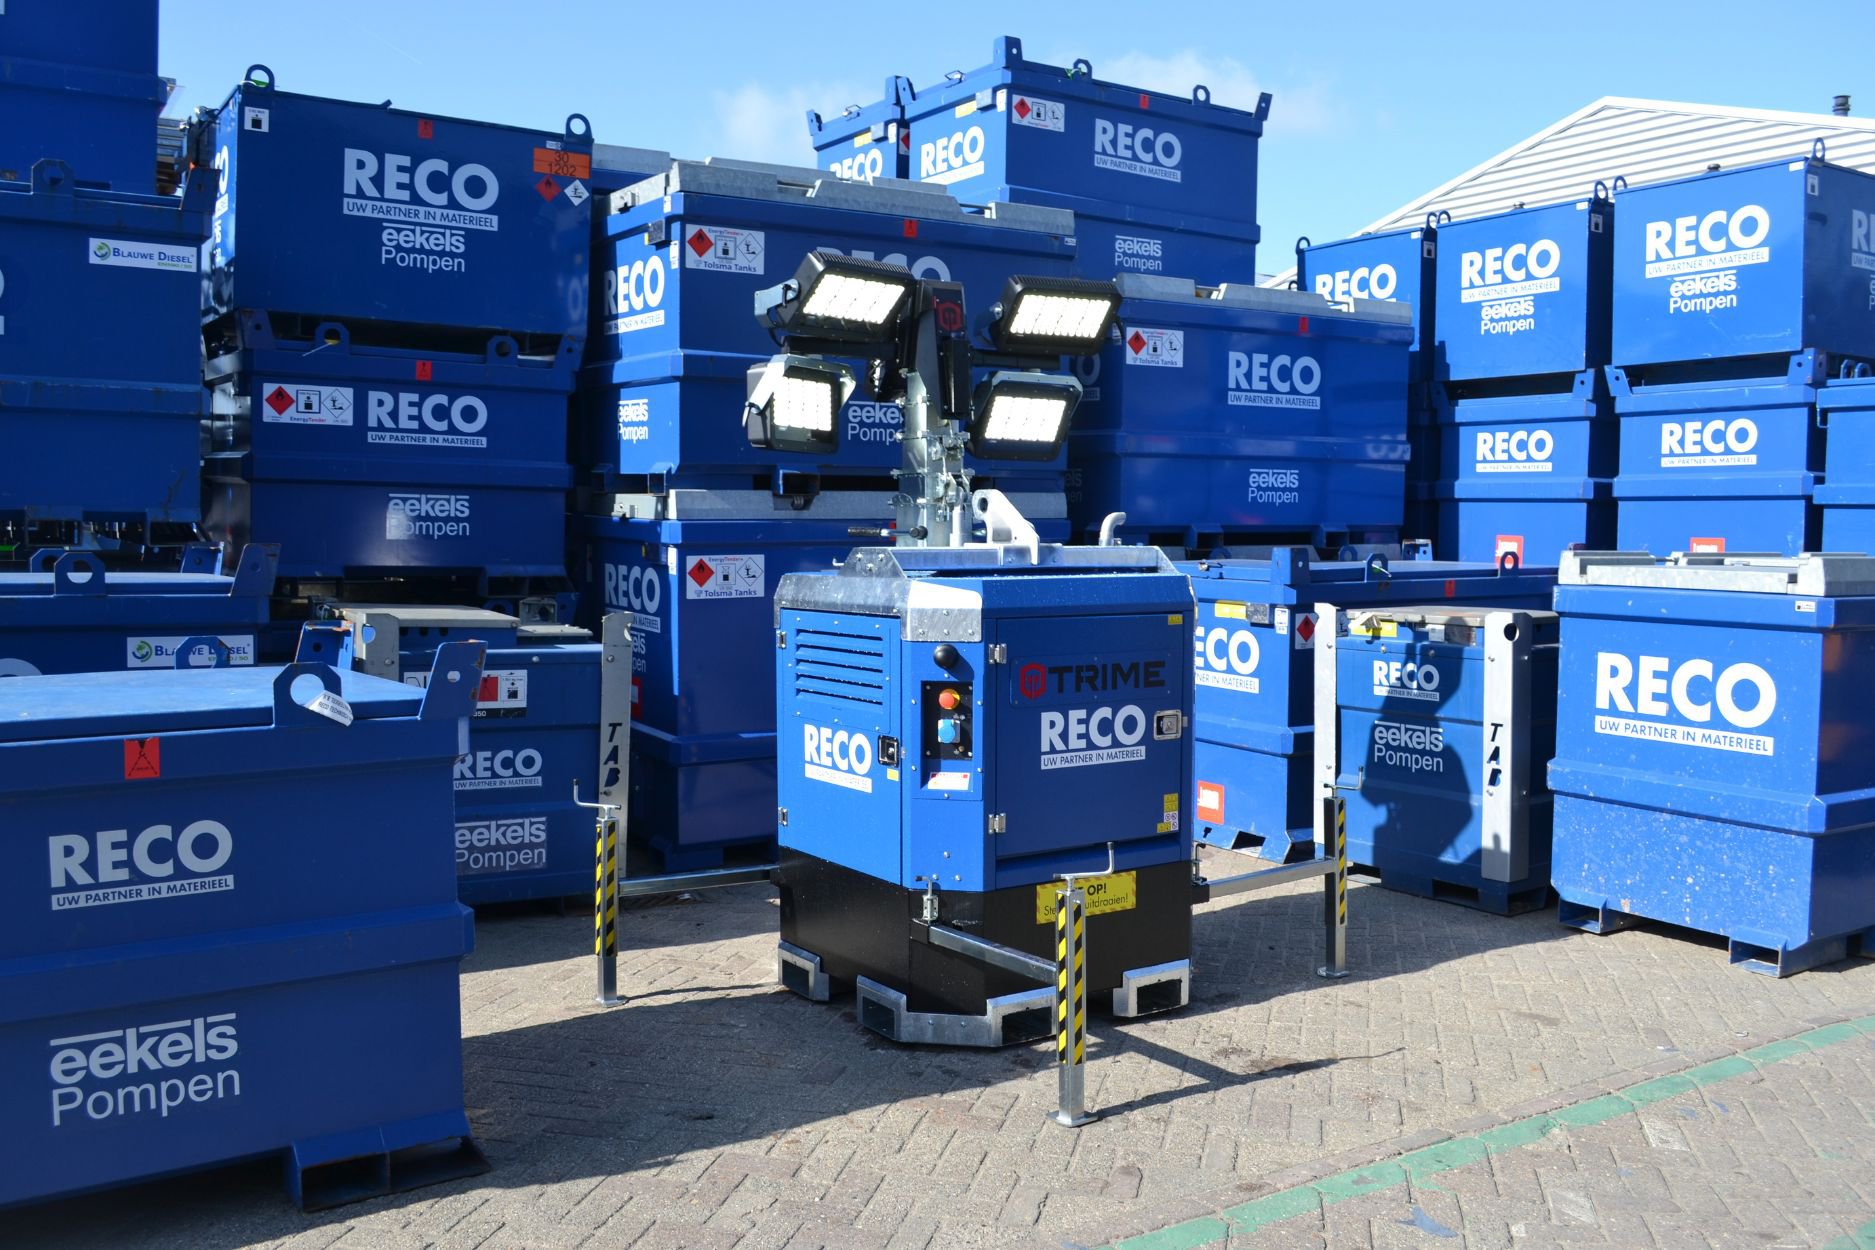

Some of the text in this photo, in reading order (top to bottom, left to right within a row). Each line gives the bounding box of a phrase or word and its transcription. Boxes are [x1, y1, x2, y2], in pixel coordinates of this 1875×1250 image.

[921, 126, 984, 178] RECO
[1095, 118, 1181, 167] RECO
[549, 163, 577, 177] 1202
[554, 152, 569, 163] 30
[1110, 160, 1137, 172] PARTNER
[1139, 164, 1146, 173] IN
[1148, 167, 1179, 180] MATERIEEL
[344, 148, 499, 211] RECO
[347, 202, 495, 228] UW PARTNER IN MATERIEEL
[382, 222, 465, 253] eekels
[1115, 235, 1162, 256] eekels
[1646, 204, 1770, 261] RECO
[382, 246, 465, 273] Pompen
[704, 261, 732, 270] Tolsma
[734, 264, 756, 272] Tanks
[1115, 252, 1162, 272] Pompen
[1461, 239, 1560, 288] RECO
[1649, 252, 1765, 276] UW PARTNER IN MATERIEEL
[604, 256, 664, 316] RECO
[1315, 264, 1397, 302] RECO
[1478, 286, 1508, 298] PARTNER
[1510, 285, 1518, 294] IN
[1521, 280, 1556, 292] MATERIEEL
[1670, 270, 1736, 297] eekels
[1481, 296, 1534, 321] eekels
[1670, 294, 1736, 314] Pompen
[1481, 317, 1534, 335] Pompen
[1228, 351, 1321, 394] RECO
[368, 391, 488, 433] RECO
[618, 399, 648, 422] eekels
[848, 401, 904, 424] eeke
[1230, 394, 1318, 407] UW PARTNER IN MATERIEEL
[371, 434, 385, 442] UW
[389, 435, 427, 443] PARTNER
[443, 437, 484, 446] MATERIEEL
[617, 422, 648, 443] Pompen
[848, 423, 903, 445] Pomp
[1476, 430, 1553, 461] RECO
[1661, 418, 1758, 454] RECO
[1720, 456, 1753, 464] MATERIEEL
[1249, 468, 1299, 488] eekels
[388, 494, 469, 517] eekels
[1248, 487, 1299, 506] Pompen
[604, 563, 660, 614] RECO
[632, 631, 646, 654] els
[1195, 626, 1259, 675] ECO
[1048, 661, 1166, 693] TRIME
[1222, 677, 1256, 690] MATERIEEL
[1373, 660, 1440, 690] RECO
[1596, 652, 1776, 728] RECO
[1041, 704, 1146, 752] RECO
[1375, 720, 1443, 751] eekels
[1600, 720, 1768, 752] UW PARTNER IN MATERIEEL
[604, 723, 623, 789] TAB
[804, 723, 872, 775] RECO
[1043, 749, 1143, 766] UW PARTNER IN MATERIEEL
[1375, 744, 1443, 772] Pompen
[1488, 723, 1503, 788] TAB
[454, 749, 542, 779] RECO
[455, 781, 467, 789] UW
[469, 780, 497, 788] PARTNER
[508, 778, 540, 787] MATERIEEL
[455, 817, 546, 848] eekels
[48, 820, 233, 888] RECO
[455, 848, 546, 870] Pompen
[57, 878, 230, 907] UW PARTNER IN MATERIEEL
[1085, 893, 1128, 909] uitdraaien!
[1087, 883, 1106, 895] OP!
[50, 1013, 239, 1085] eekels
[52, 1068, 241, 1126] Pompen
